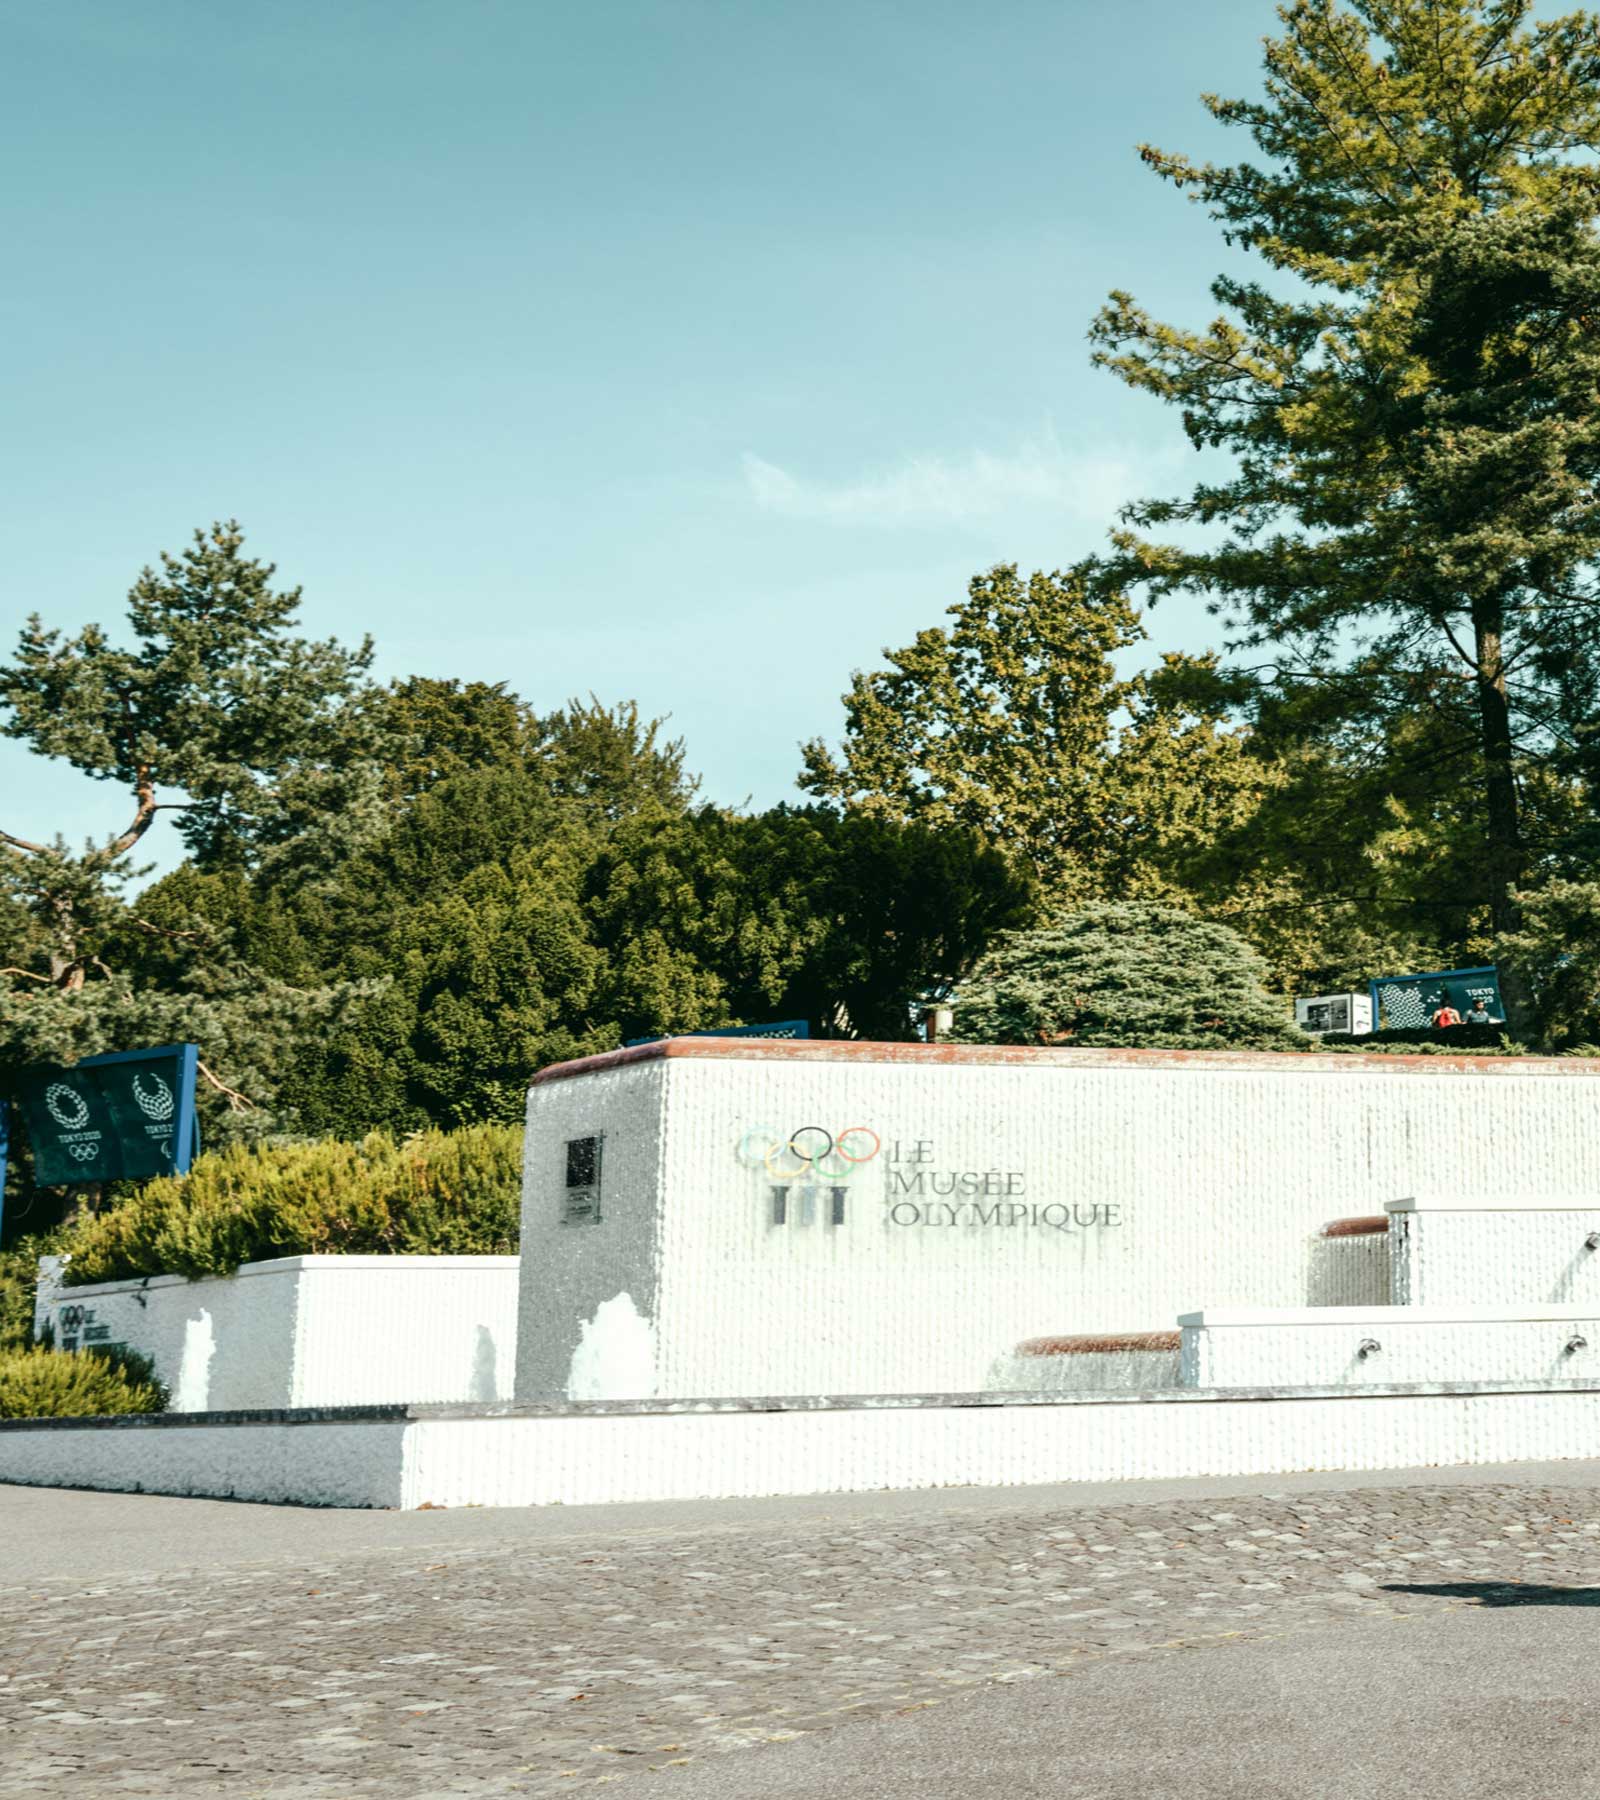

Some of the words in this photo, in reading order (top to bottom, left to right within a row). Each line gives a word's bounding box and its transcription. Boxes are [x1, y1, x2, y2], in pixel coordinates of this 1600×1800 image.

[1465, 987, 1495, 997] TOKYO
[891, 1140, 935, 1163] LE
[891, 1168, 1026, 1195] MUSÉE
[891, 1202, 1122, 1233] OLYMPIQUE
